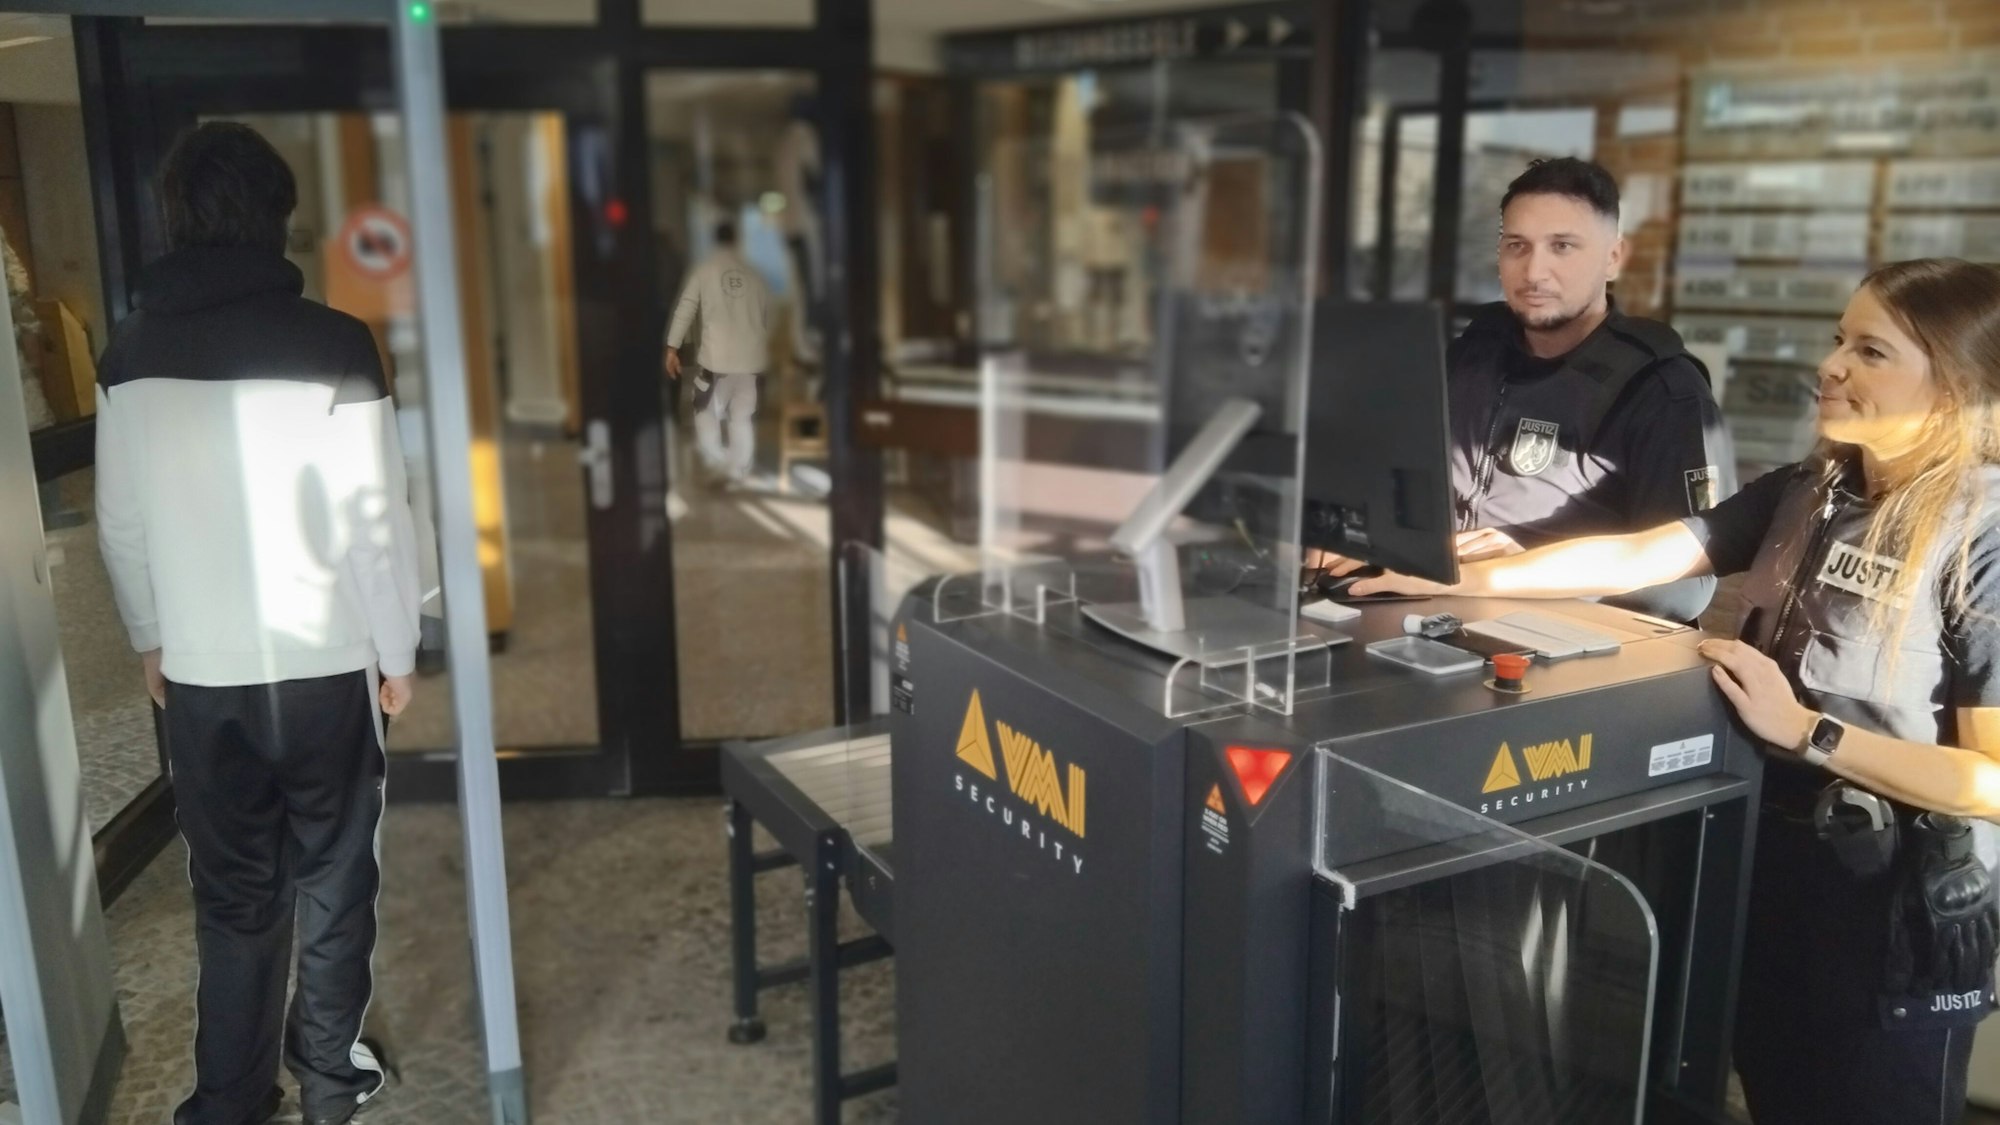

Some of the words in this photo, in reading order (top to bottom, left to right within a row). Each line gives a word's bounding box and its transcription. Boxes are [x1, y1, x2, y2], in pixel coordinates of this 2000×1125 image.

[1521, 420, 1555, 436] JUSTIZ
[1690, 470, 1714, 482] JUS
[1827, 552, 1903, 592] JUSTI
[1480, 779, 1588, 814] SECURITY
[955, 774, 1083, 875] SECURITY
[1930, 989, 1982, 1012] JUSTIZ
